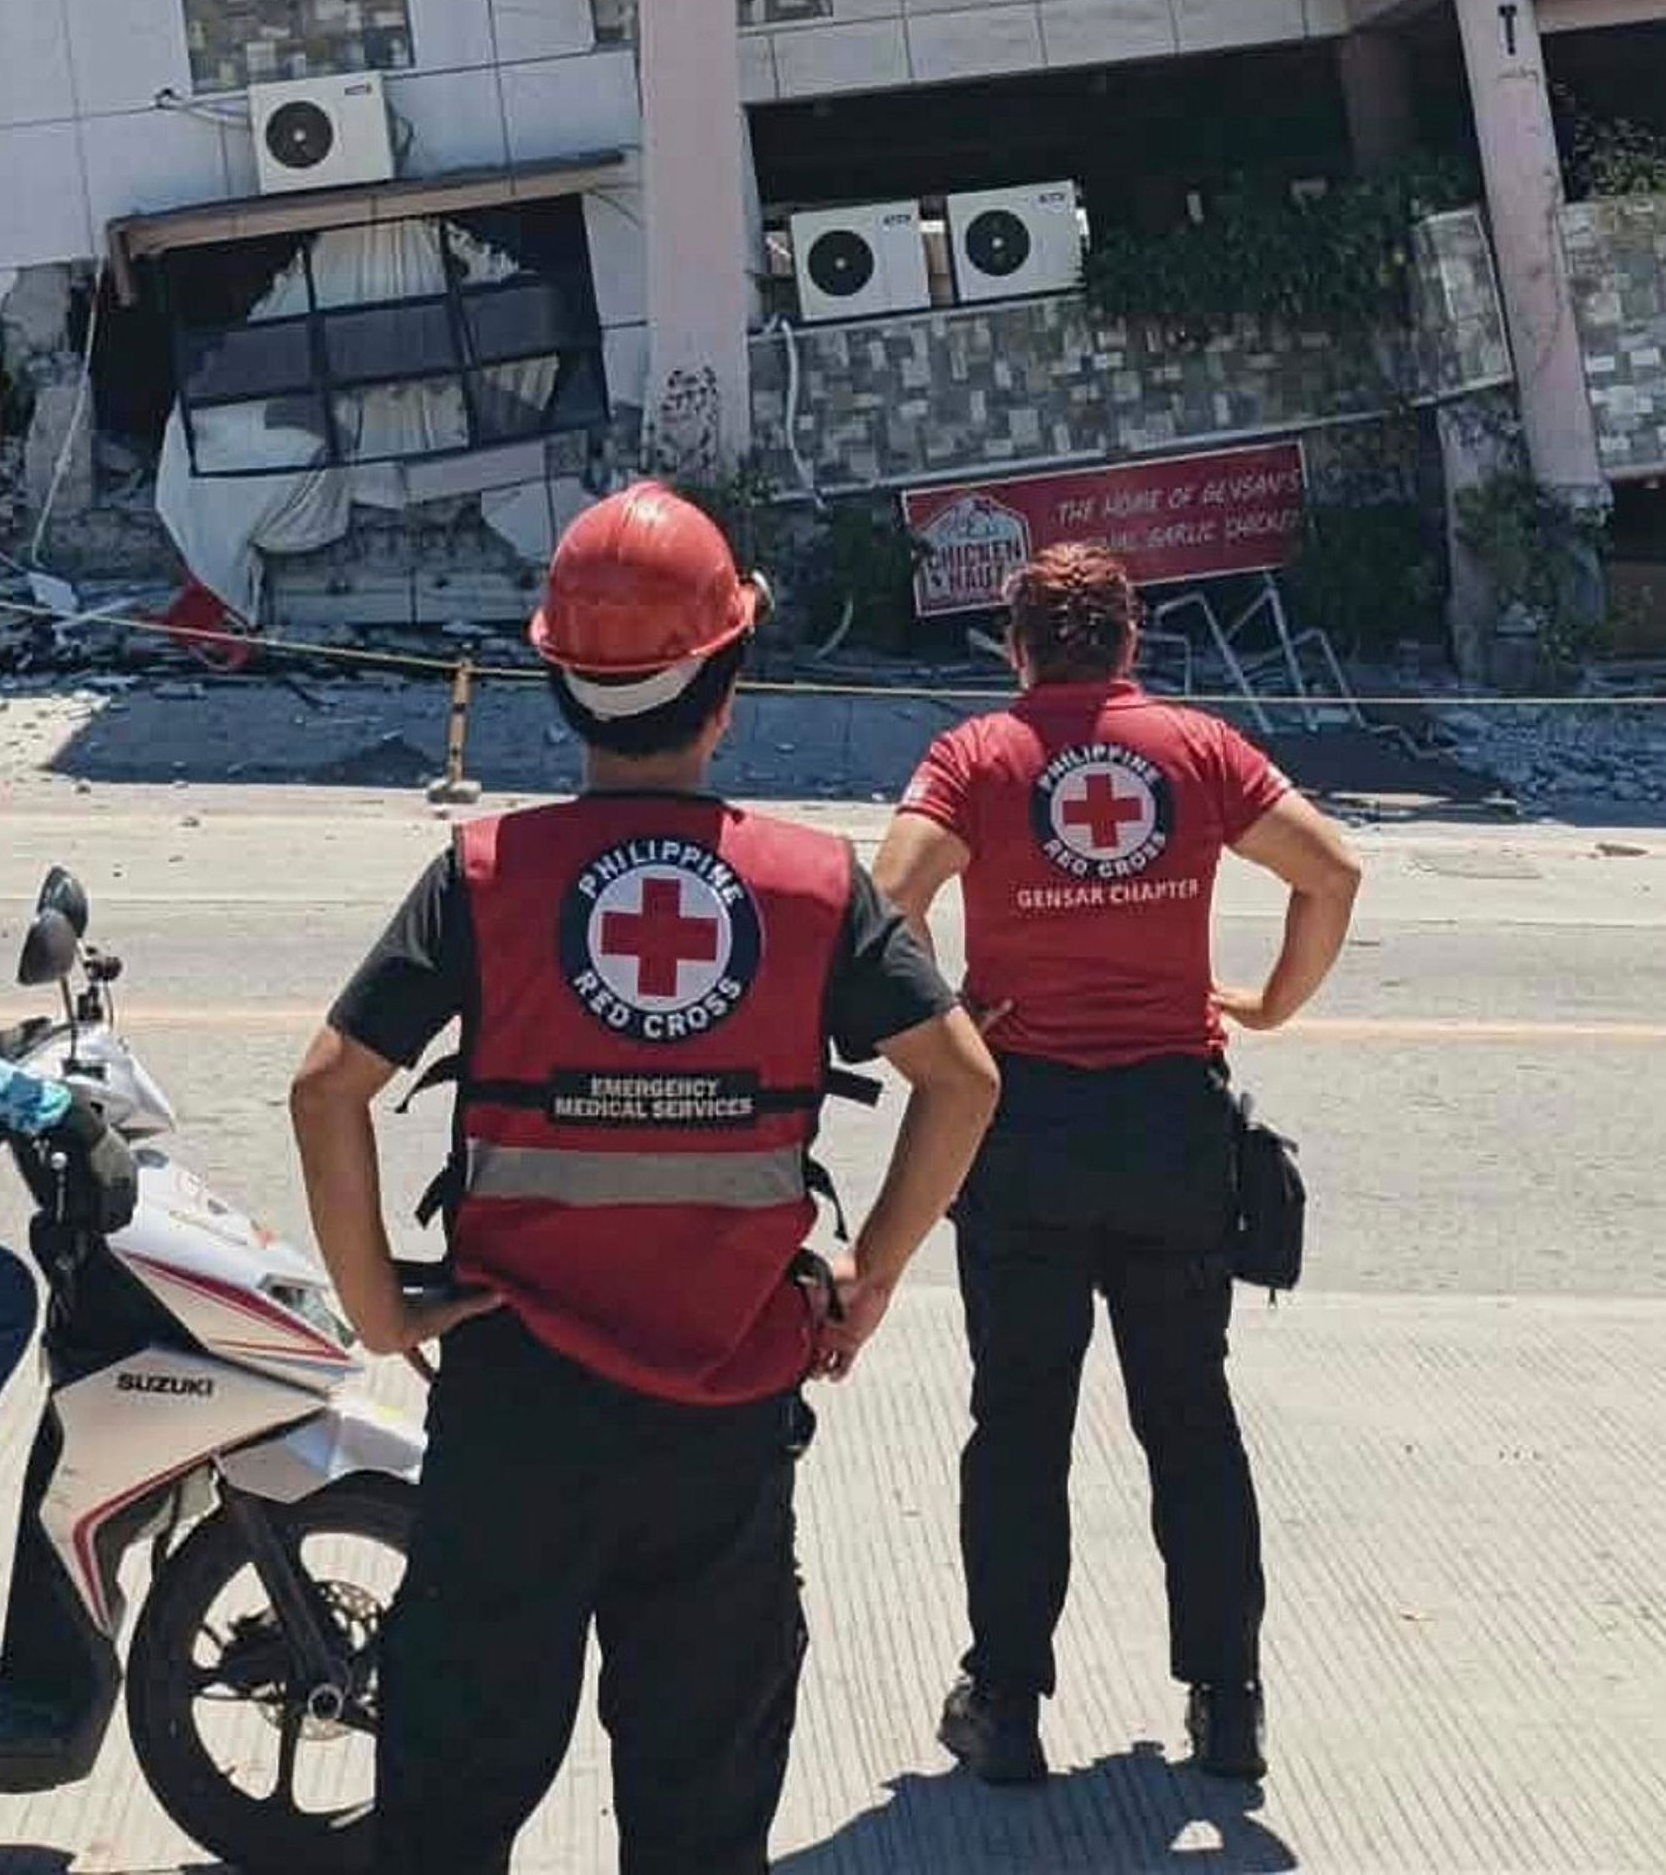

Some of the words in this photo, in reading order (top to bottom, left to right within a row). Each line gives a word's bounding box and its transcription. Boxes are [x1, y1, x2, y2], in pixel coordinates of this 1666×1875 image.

[1037, 744, 1162, 791] PHILIPPINE
[578, 839, 744, 905] PHILIPPINE
[1098, 831, 1166, 878] CROSS
[1109, 878, 1198, 904] CHAPTER
[572, 971, 631, 1029] RED
[643, 977, 742, 1039] CROSS
[591, 1075, 719, 1097] EMERGENCY
[554, 1096, 648, 1118] MEDICAL
[652, 1097, 754, 1119] SERVICES
[116, 1372, 215, 1398] SUZUKI
